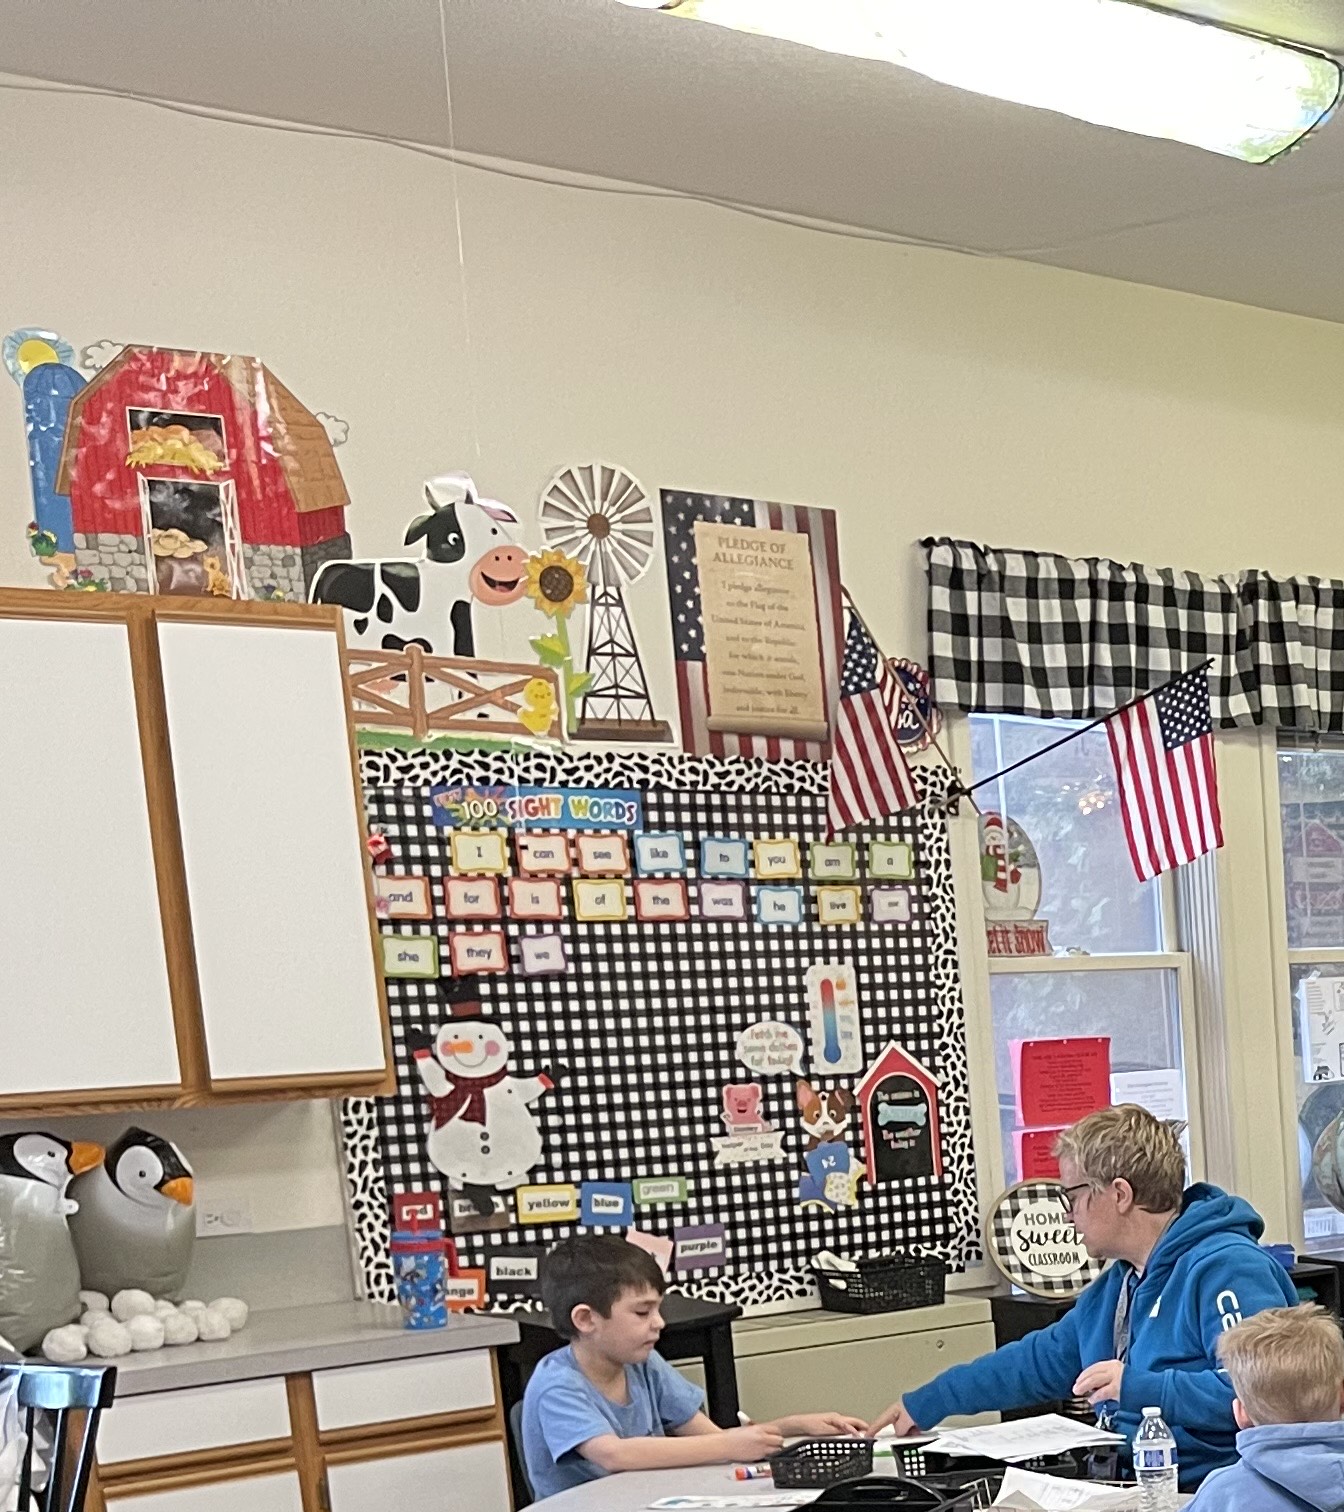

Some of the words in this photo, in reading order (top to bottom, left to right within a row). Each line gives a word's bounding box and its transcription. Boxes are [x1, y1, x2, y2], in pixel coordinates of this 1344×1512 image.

[718, 537, 767, 552] PLEDGE
[770, 543, 786, 554] OF
[713, 552, 794, 570] ALLEGIANCE
[461, 799, 498, 819] 100
[506, 794, 564, 821] SIGHT
[568, 795, 638, 825] WORDS
[533, 849, 555, 859] can
[650, 847, 669, 859] like
[767, 856, 786, 867] you
[825, 858, 841, 867] am
[388, 891, 413, 903] and
[463, 892, 480, 904] for
[652, 894, 670, 905] the
[773, 901, 786, 912] he
[397, 950, 420, 963] she
[466, 947, 493, 960] they
[534, 951, 550, 961] we
[641, 1183, 675, 1195] green
[527, 1199, 570, 1212] yellow
[594, 1197, 620, 1209] blue
[1024, 1213, 1068, 1225] HOME
[1017, 1227, 1083, 1252] sweet
[680, 1239, 718, 1254] purple
[1028, 1252, 1080, 1266] CLASSROOM
[496, 1265, 532, 1277] black
